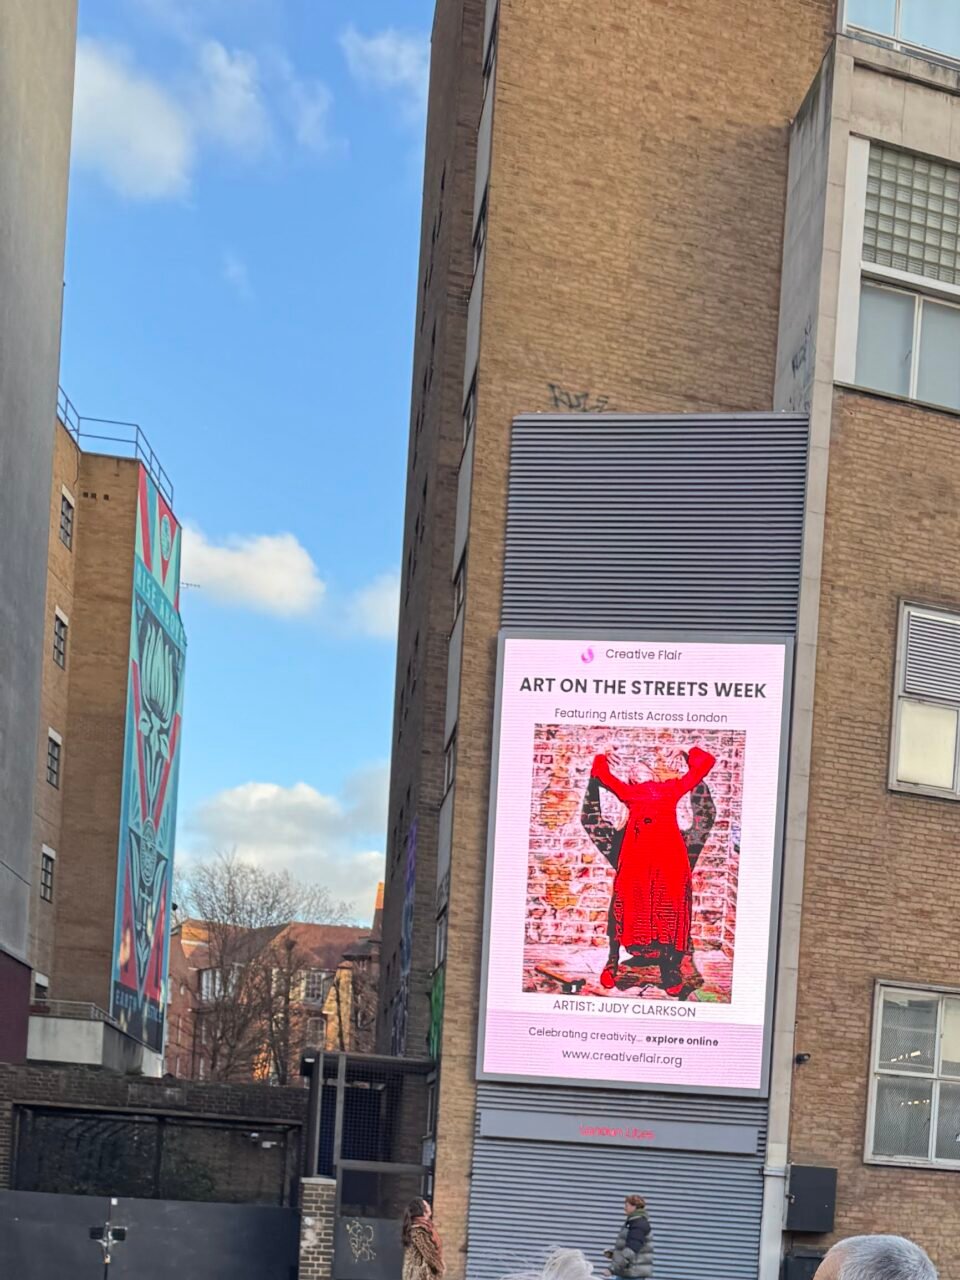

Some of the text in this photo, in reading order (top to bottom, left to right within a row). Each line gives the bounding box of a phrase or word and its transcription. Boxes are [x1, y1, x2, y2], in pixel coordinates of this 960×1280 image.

[605, 648, 683, 661] Creative Flair
[519, 676, 768, 699] ART ON THE STREETS WEEK
[554, 707, 728, 723] Featuring Artists Across London
[552, 999, 697, 1018] ARTIST: JUDY CLARKSON
[528, 1026, 588, 1041] Celebrating
[645, 1034, 685, 1045] explore
[686, 1036, 720, 1047] online
[561, 1049, 683, 1068] www.creativeflair.org
